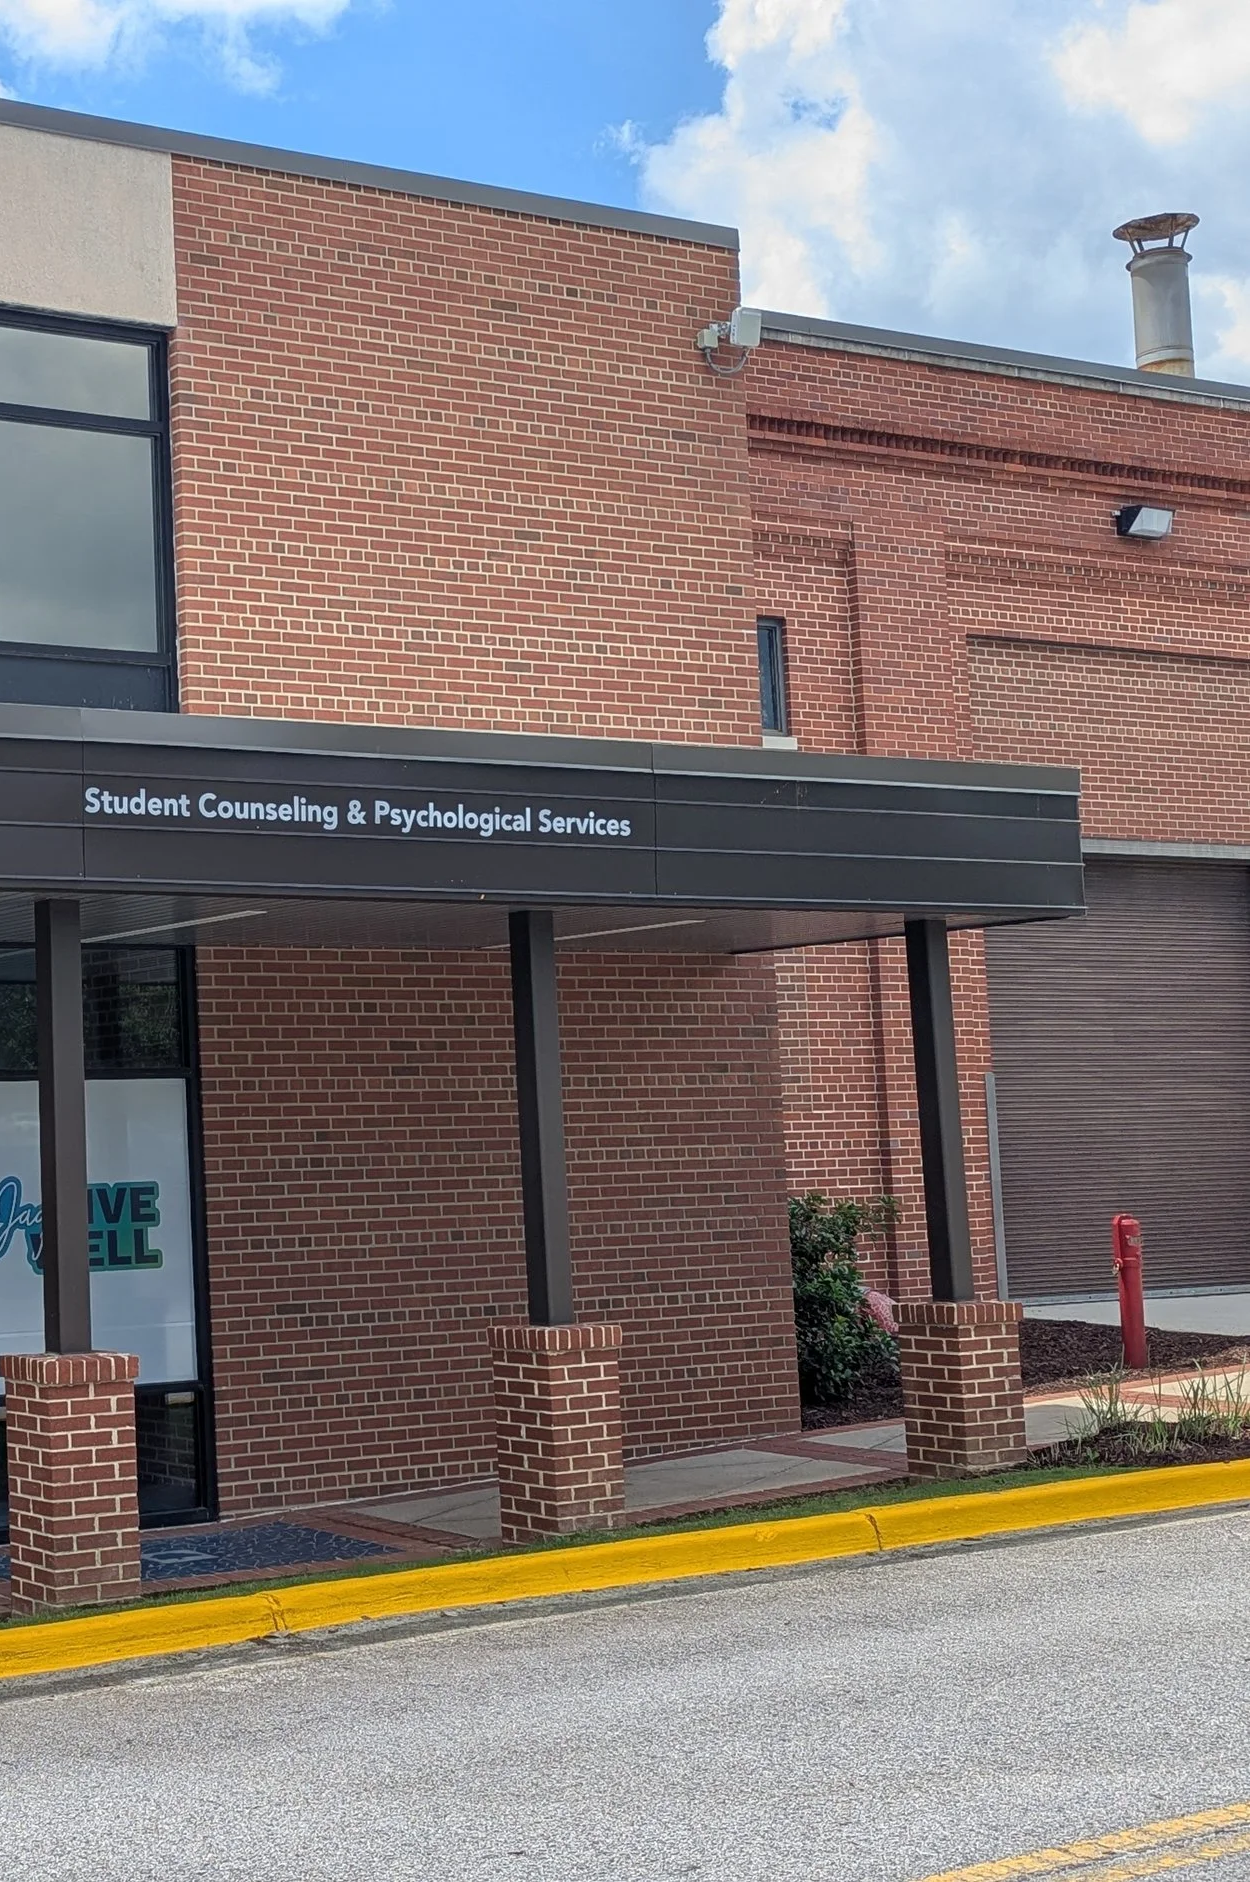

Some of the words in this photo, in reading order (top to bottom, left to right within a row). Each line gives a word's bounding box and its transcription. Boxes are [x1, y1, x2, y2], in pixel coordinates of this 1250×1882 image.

[84, 786, 191, 818] Student
[198, 792, 339, 831] Counseling
[346, 799, 367, 825] &
[374, 800, 531, 837] Psychological
[538, 808, 631, 837] Services
[88, 1187, 156, 1224] IVE
